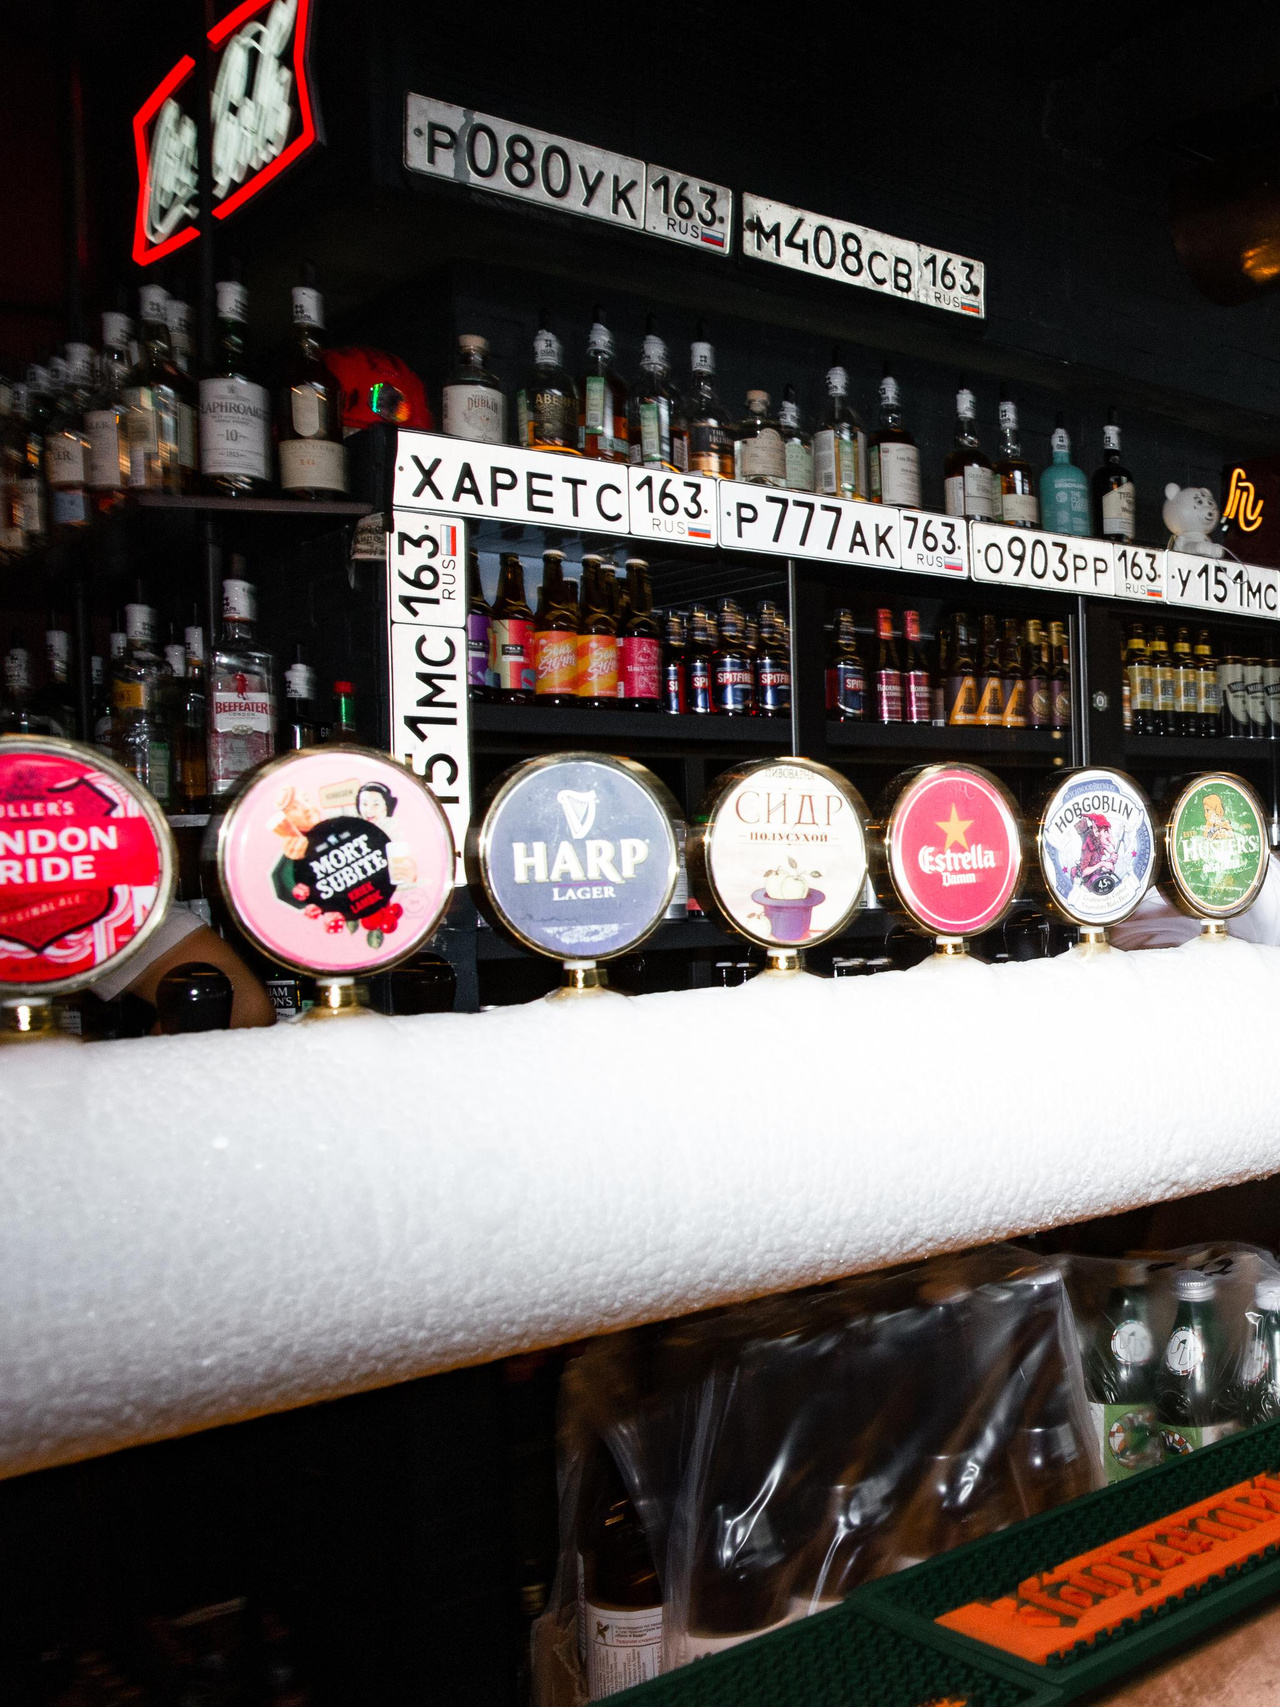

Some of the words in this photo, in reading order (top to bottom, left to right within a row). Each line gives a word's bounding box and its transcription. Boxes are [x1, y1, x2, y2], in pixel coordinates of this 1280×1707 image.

[426, 121, 637, 220] Р080УК
[650, 174, 717, 227] 163
[667, 217, 700, 239] RUS
[754, 215, 912, 293] М408СВ
[923, 254, 975, 294] 163
[934, 292, 960, 308] RUS
[225, 430, 238, 441] 10
[411, 455, 622, 521] ХАРЕТС
[636, 475, 702, 519] 163
[653, 518, 685, 534] RUS
[736, 495, 895, 559] Р777АК
[903, 515, 956, 555] 763
[398, 531, 440, 618] 163
[917, 553, 943, 568] RUS
[1117, 550, 1157, 582] 163
[442, 558, 456, 600] RUS
[1126, 583, 1146, 595] RUS
[1177, 563, 1278, 611] У151МС
[215, 701, 269, 714] BEEFEATER
[735, 791, 843, 828] СИДР
[1055, 795, 1133, 834] HOBGOBLIN
[750, 831, 828, 842] ПОЛУСУХОЙ
[309, 833, 373, 880] MORT
[512, 838, 649, 884] HARP
[918, 844, 996, 874] Estrella
[316, 849, 388, 900] SUBITE
[942, 872, 977, 887] Damm
[552, 886, 616, 901] LAGER
